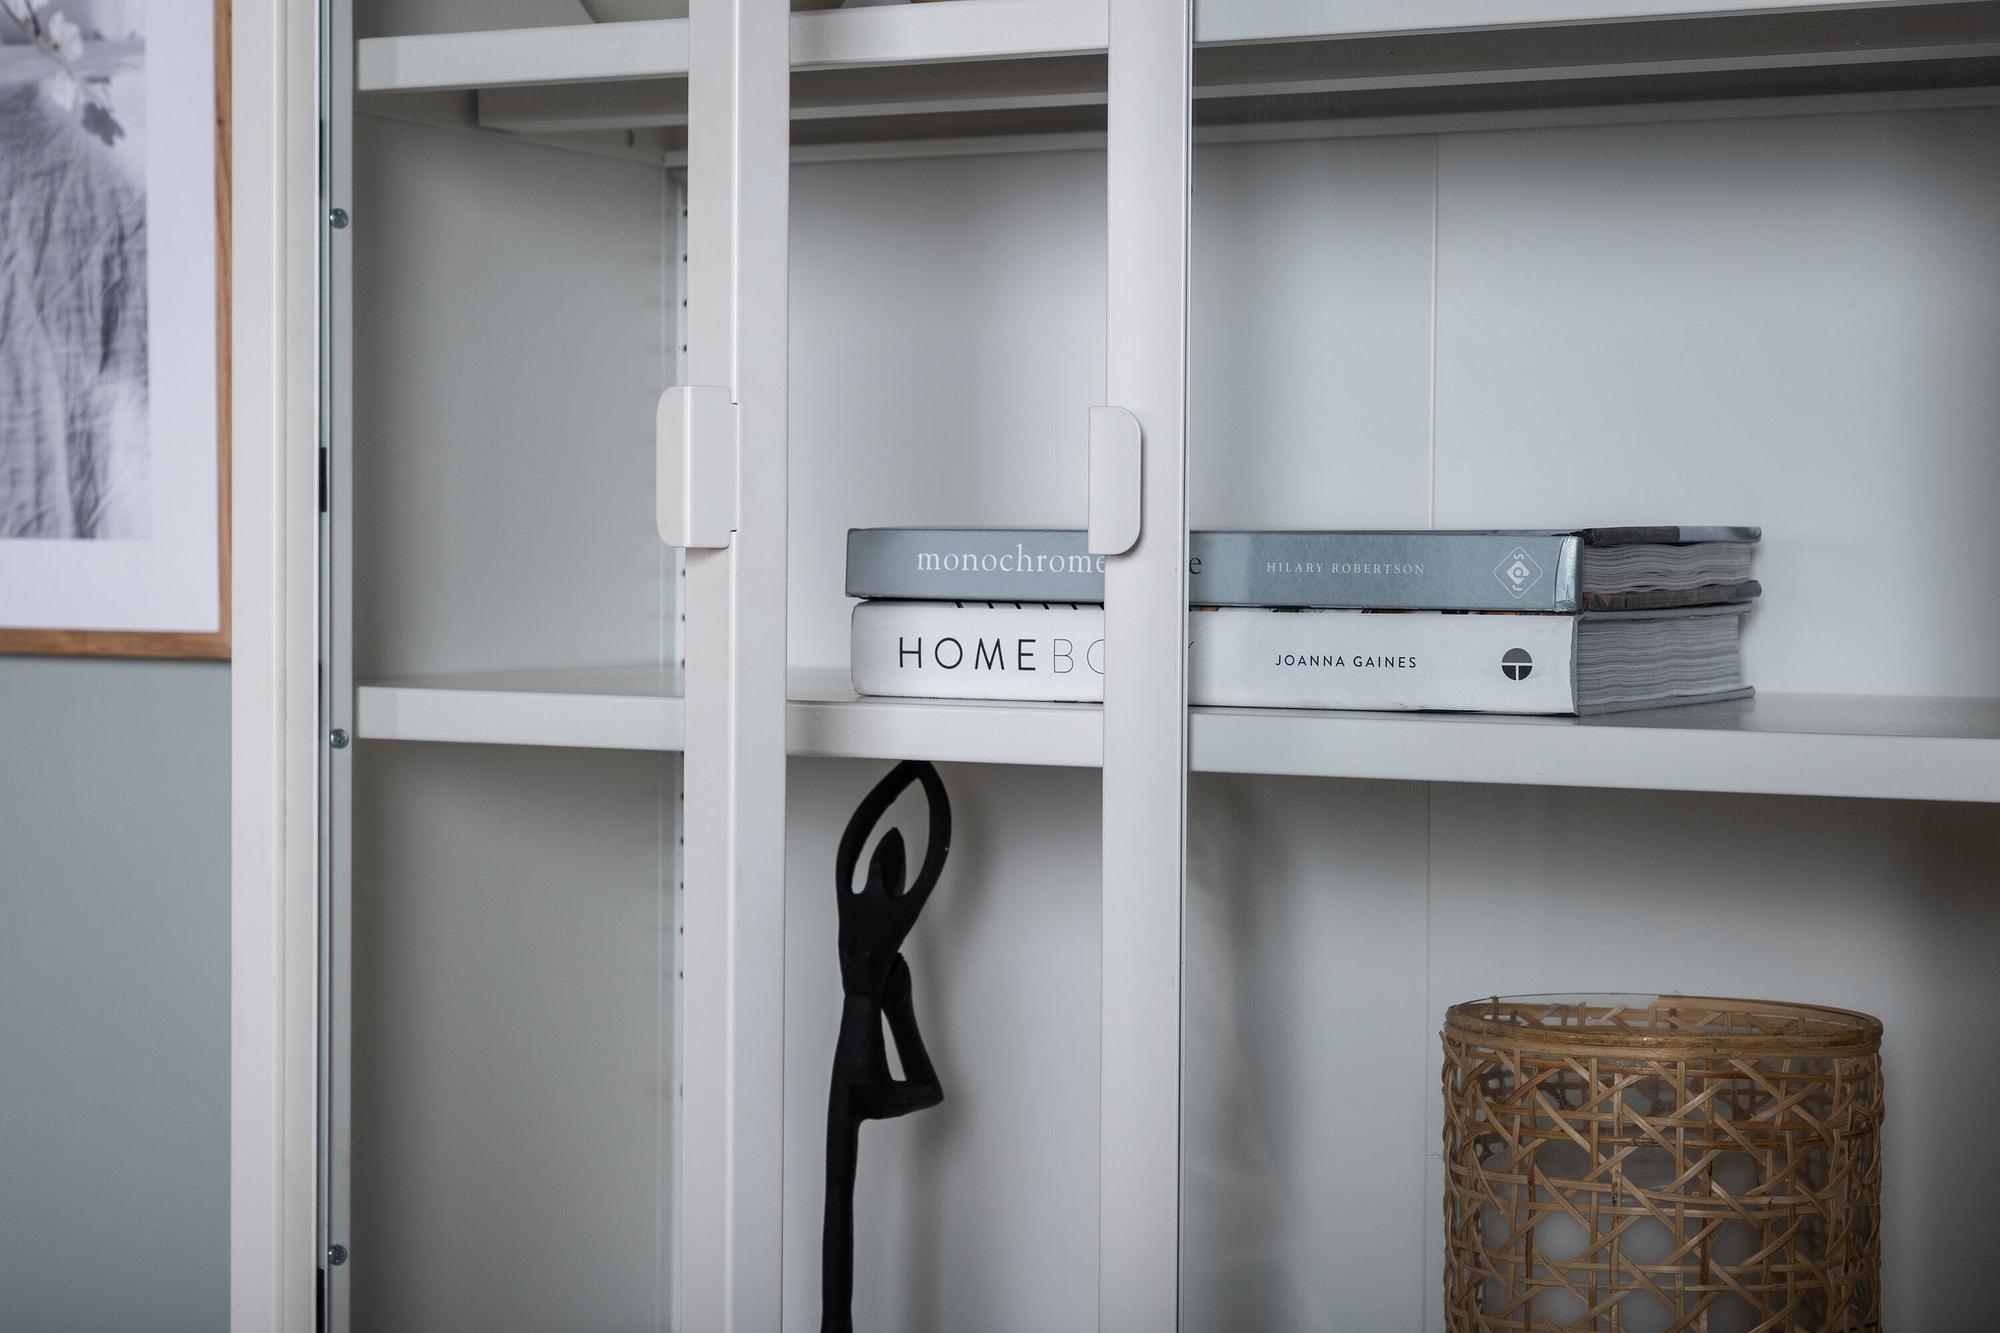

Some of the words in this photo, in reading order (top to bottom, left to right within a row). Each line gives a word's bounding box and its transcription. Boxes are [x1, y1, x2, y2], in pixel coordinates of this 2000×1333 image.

[1266, 561, 1324, 575] HILARY
[1331, 562, 1425, 576] ROBERTSON
[1275, 654, 1345, 668] JOANNA
[1353, 655, 1417, 669] GAINES
